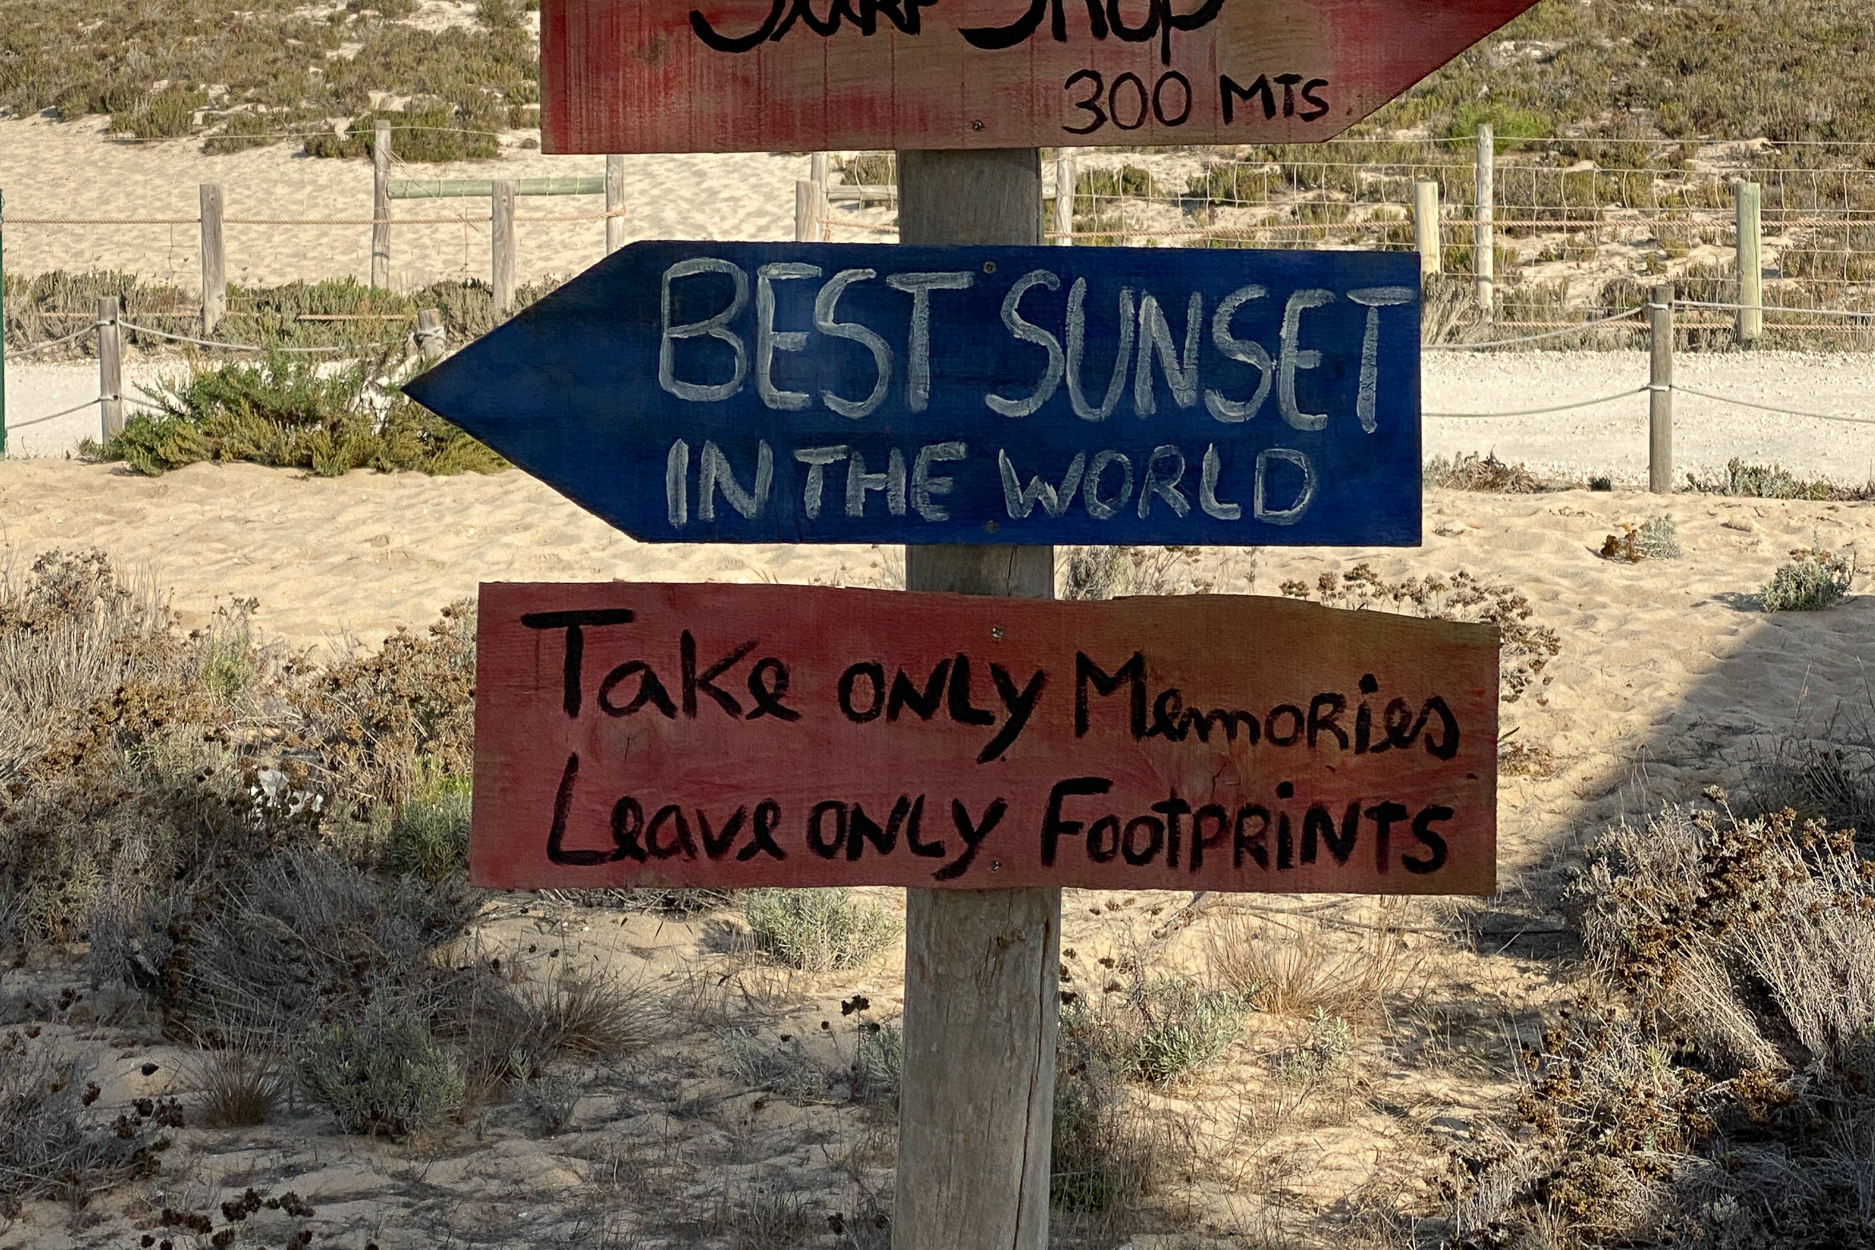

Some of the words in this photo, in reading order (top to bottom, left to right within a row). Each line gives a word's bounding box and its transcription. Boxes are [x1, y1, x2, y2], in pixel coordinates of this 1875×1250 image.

[1061, 69, 1193, 134] 300
[1220, 72, 1331, 124] MTS
[658, 256, 976, 420] BEST
[985, 268, 1417, 434] SUNSET
[666, 438, 774, 527] IN
[794, 440, 968, 523] THE
[998, 440, 1318, 526] WORLD
[545, 752, 790, 867] Leave
